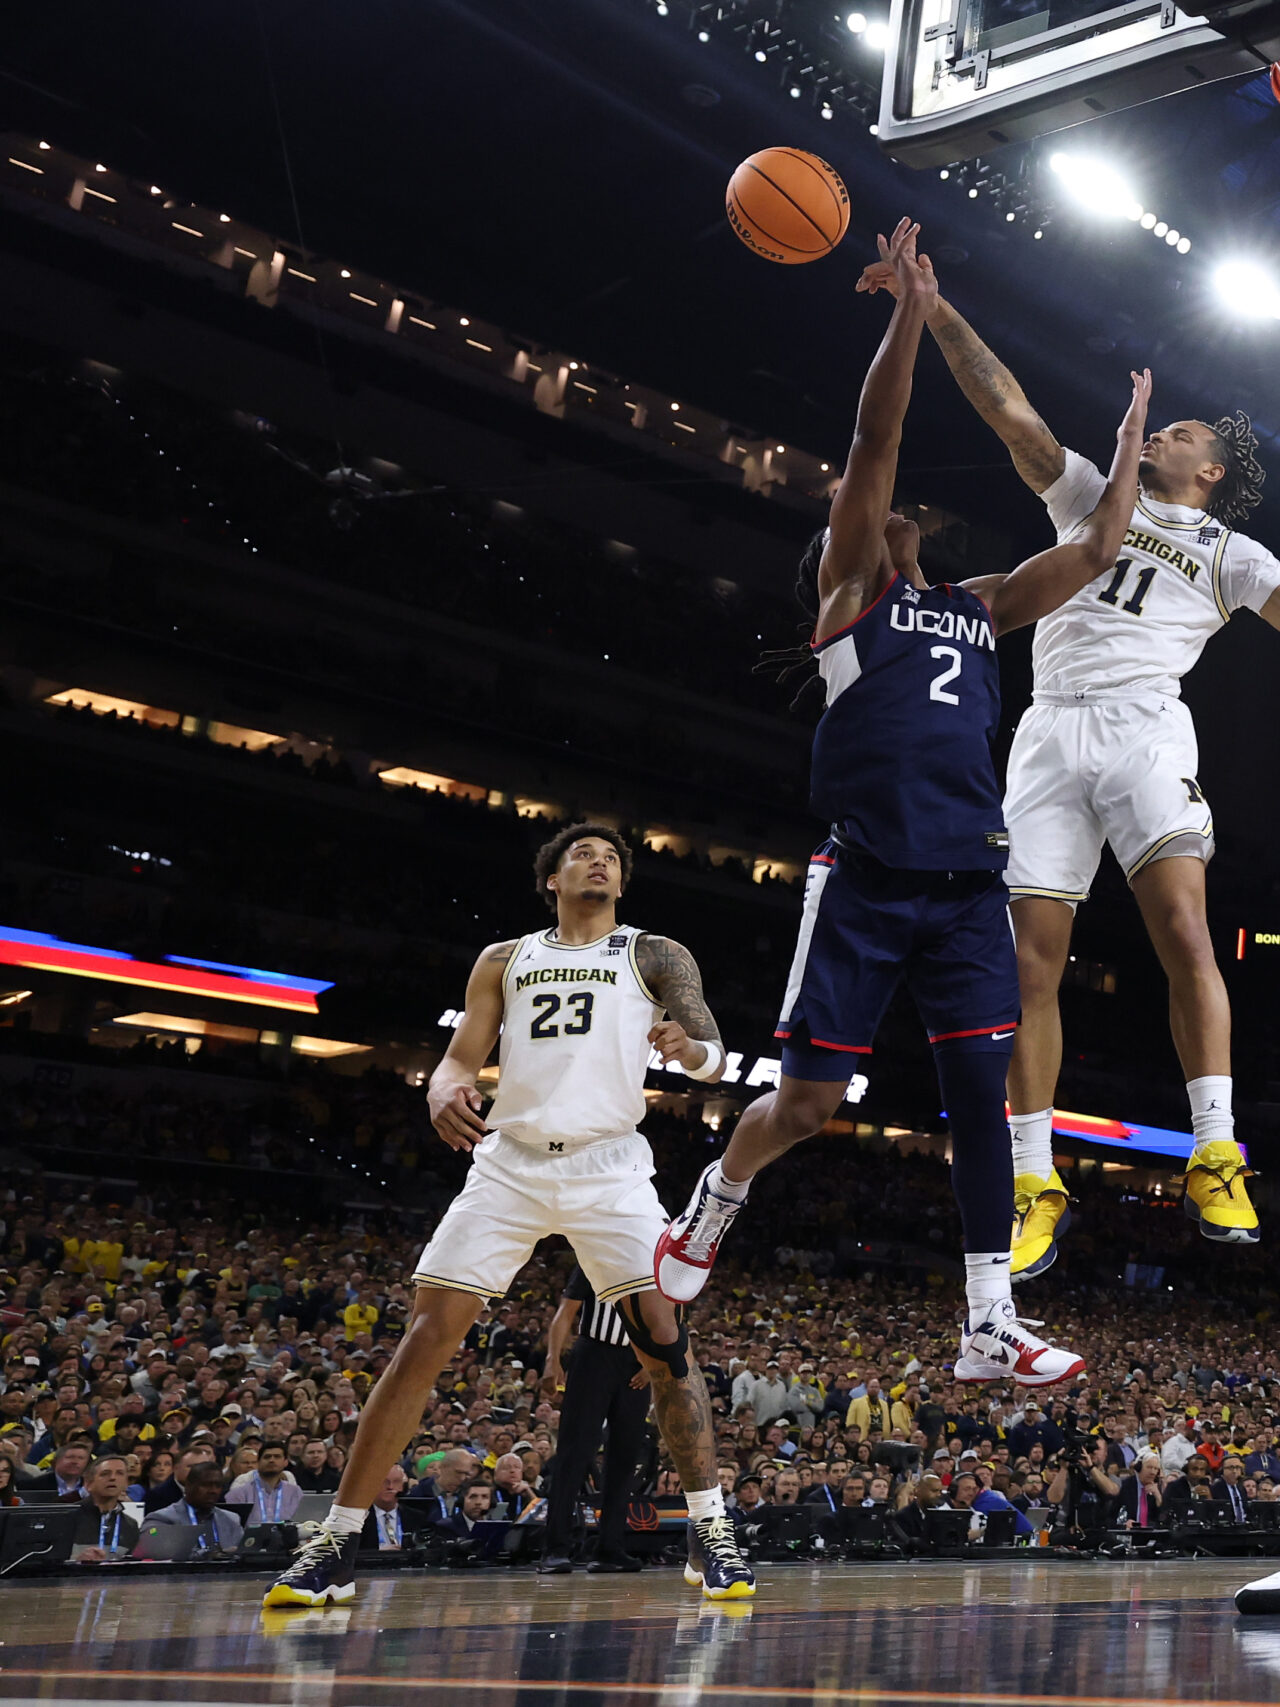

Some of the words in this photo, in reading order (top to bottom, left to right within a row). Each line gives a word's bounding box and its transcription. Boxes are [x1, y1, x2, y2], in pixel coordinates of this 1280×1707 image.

[1122, 528, 1201, 583] CHIGAN
[1098, 558, 1158, 616] 11
[890, 603, 996, 651] UCONN
[929, 645, 962, 706] 2
[516, 968, 617, 992] MICHIGAN
[531, 992, 594, 1039] 23
[548, 1141, 564, 1152] M
[478, 1334, 488, 1348] 2
